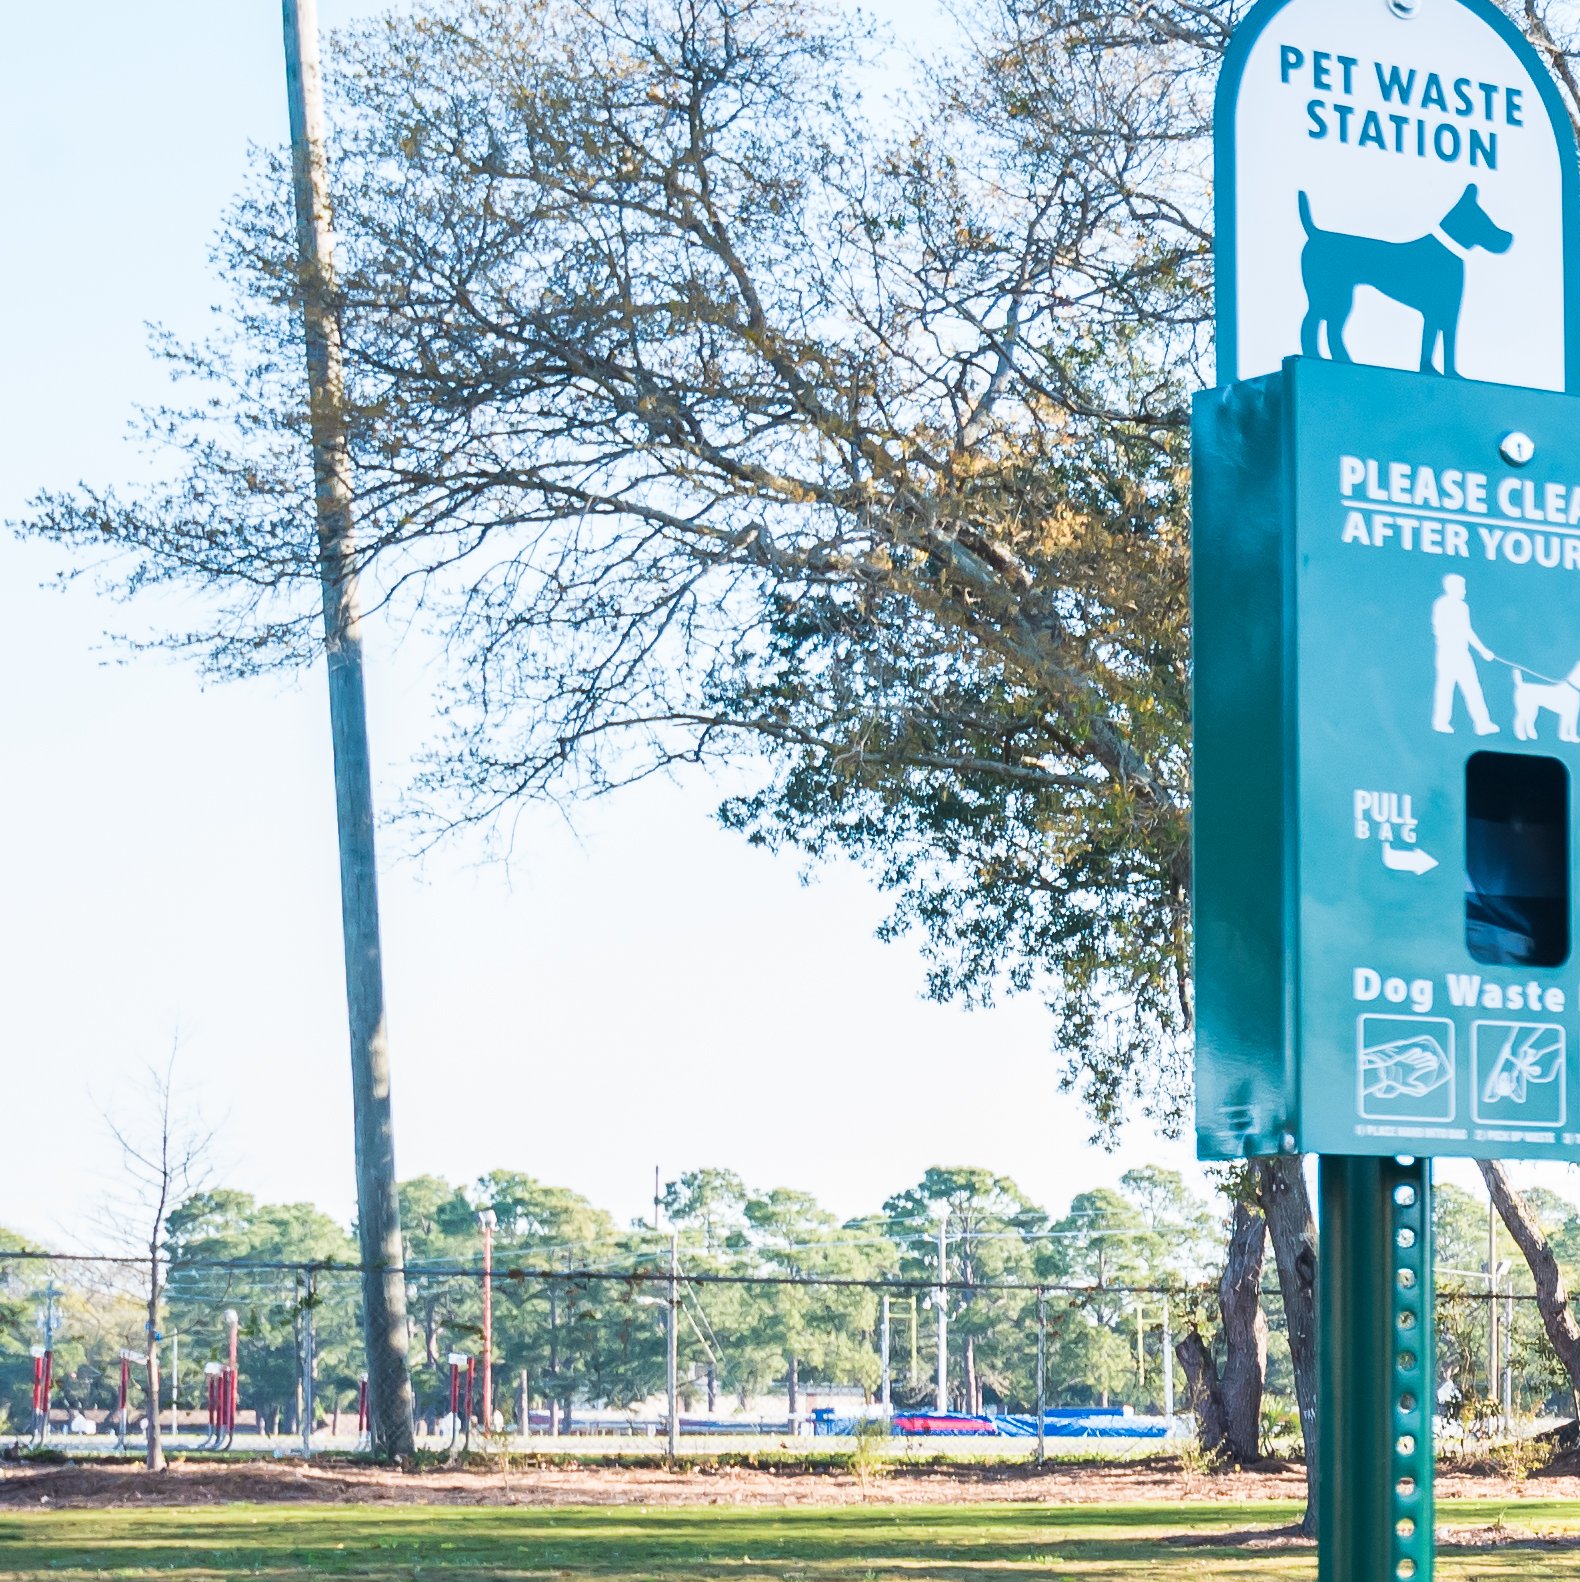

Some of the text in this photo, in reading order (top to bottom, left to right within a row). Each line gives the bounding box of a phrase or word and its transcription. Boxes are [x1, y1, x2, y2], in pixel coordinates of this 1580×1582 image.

[1280, 44, 1524, 128] PET WASTE
[1307, 99, 1498, 171] STATION
[1339, 454, 1488, 514] PLEASE
[1341, 510, 1470, 558] AFTER
[1353, 788, 1419, 826] PULL
[1352, 967, 1434, 1014] Dog
[1446, 973, 1566, 1013] Waste
